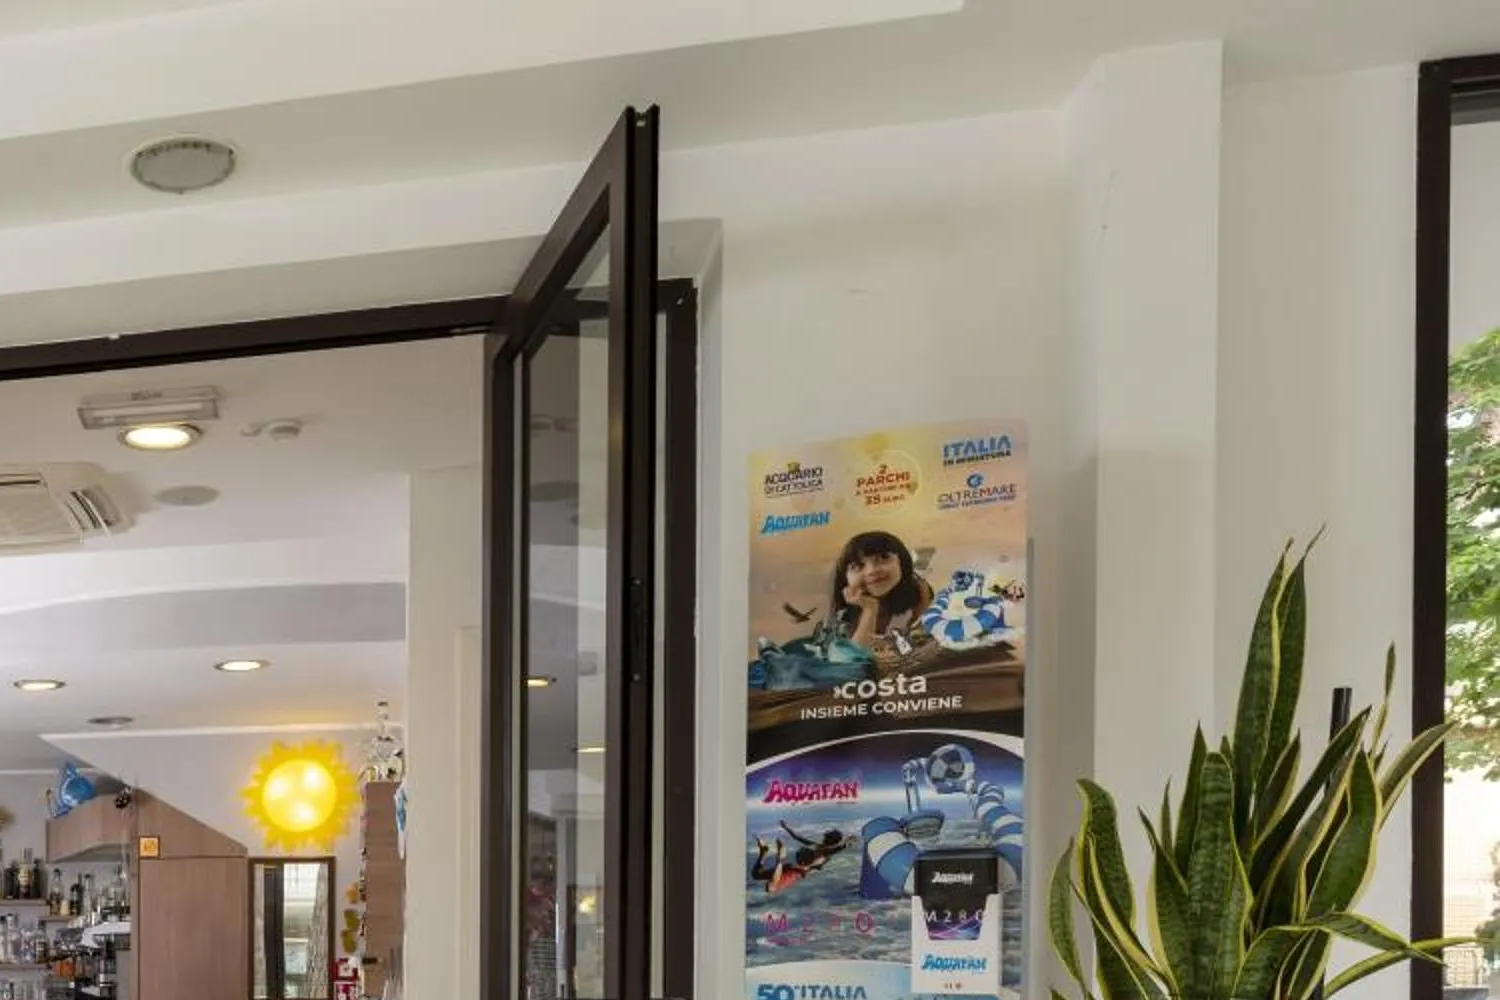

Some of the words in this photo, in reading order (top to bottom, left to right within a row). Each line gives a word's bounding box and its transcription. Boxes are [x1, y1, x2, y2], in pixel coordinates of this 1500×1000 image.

[943, 435, 1011, 457] ITALIA
[856, 471, 911, 488] PARCHI
[801, 704, 869, 720] INSIEME
[872, 695, 963, 714] CONVIENE
[801, 985, 867, 1000] ITALIA
